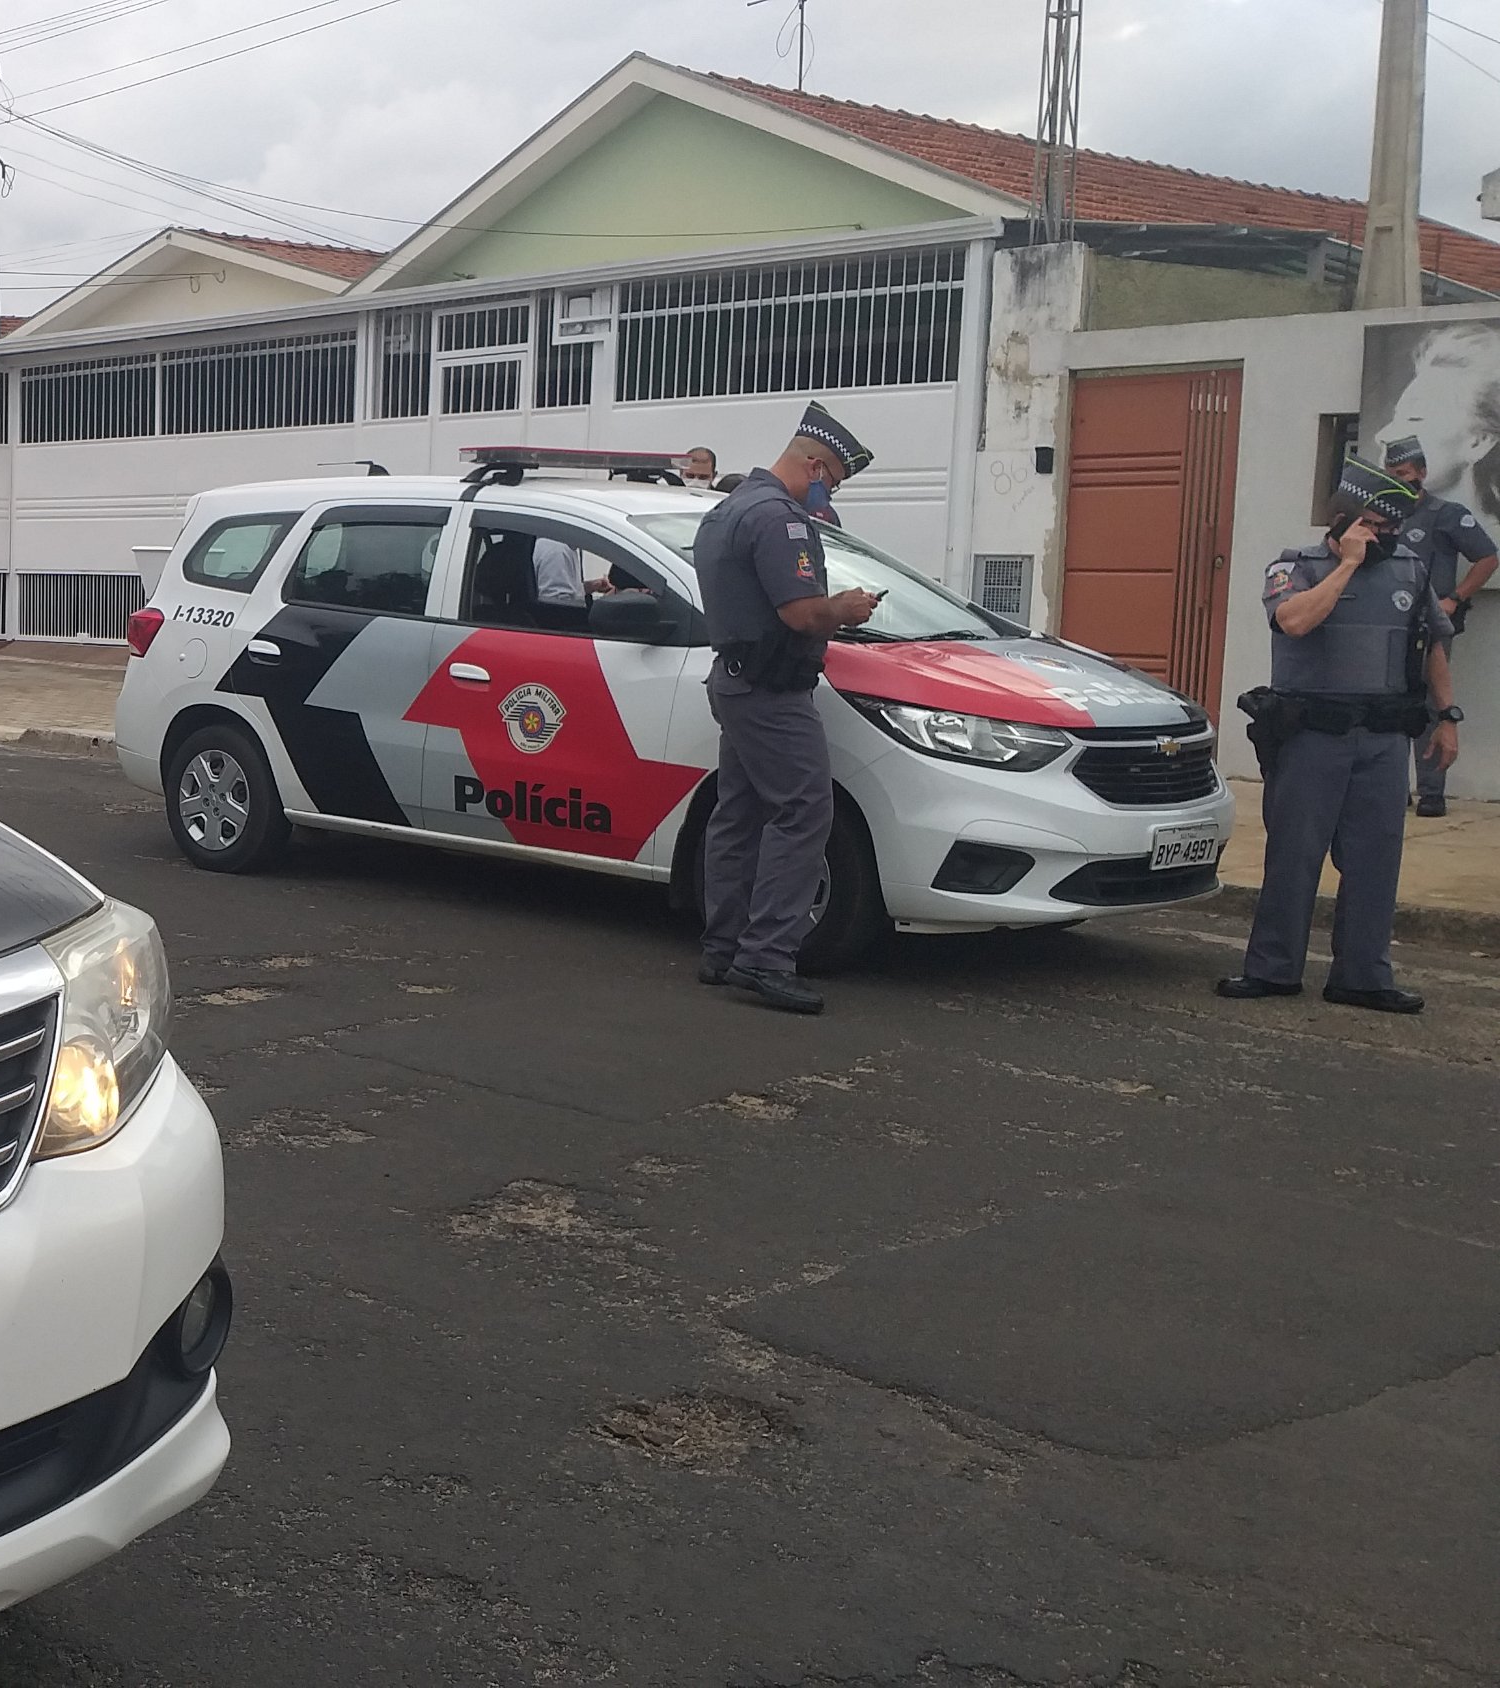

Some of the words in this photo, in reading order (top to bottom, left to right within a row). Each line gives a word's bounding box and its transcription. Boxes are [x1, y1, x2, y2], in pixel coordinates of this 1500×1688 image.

[172, 605, 235, 628] I-13320
[534, 688, 561, 716] MILITAR
[454, 775, 612, 834] Polícia
